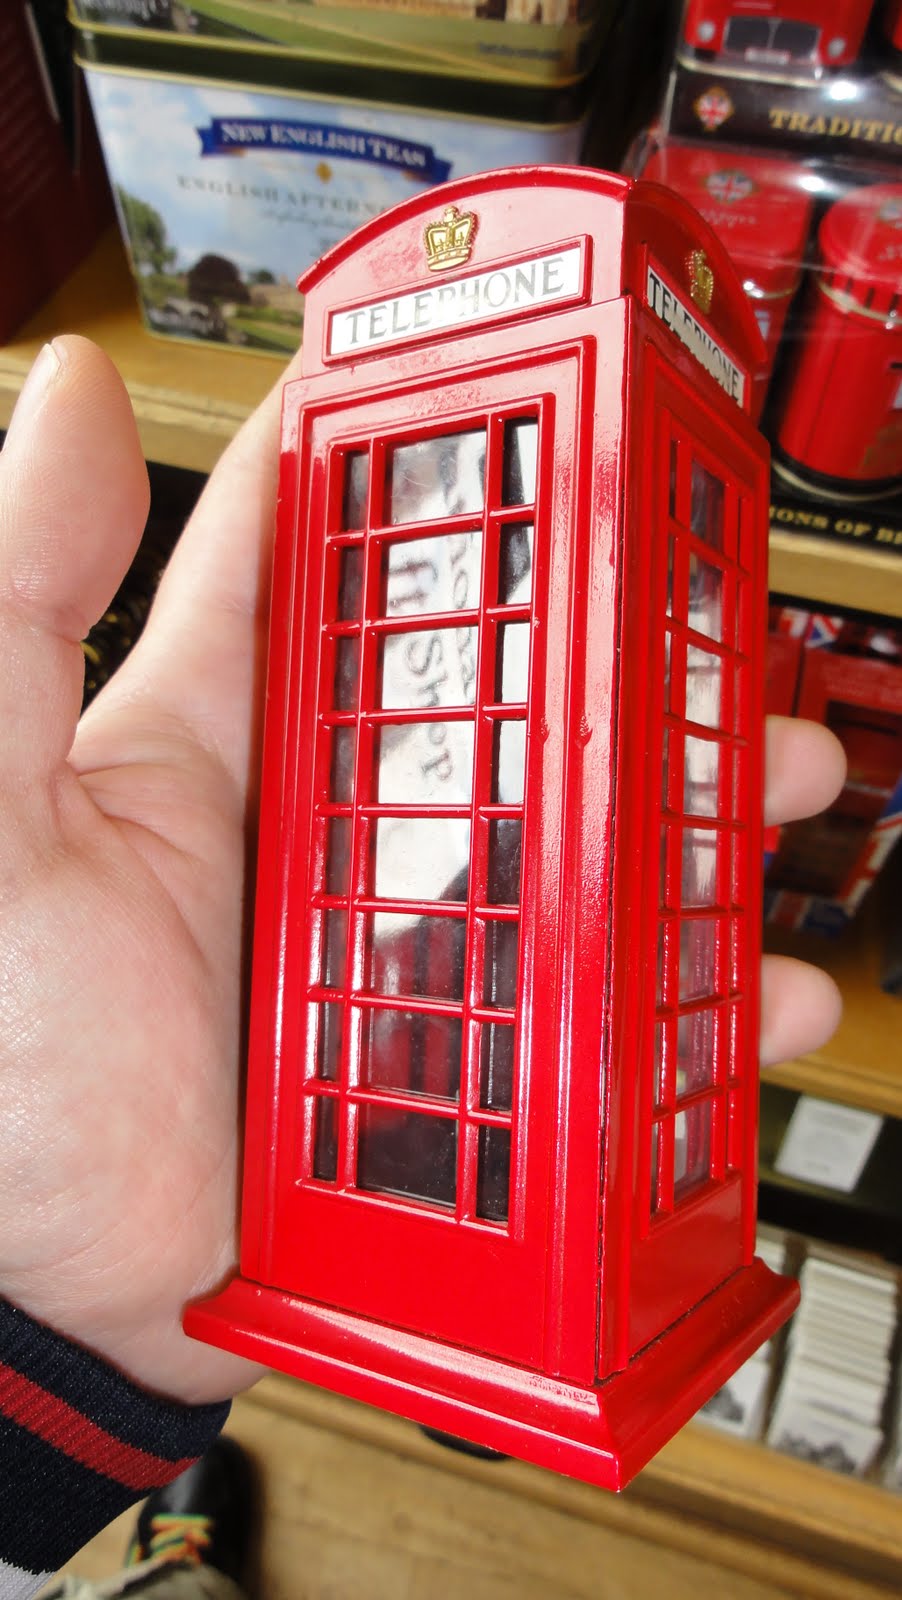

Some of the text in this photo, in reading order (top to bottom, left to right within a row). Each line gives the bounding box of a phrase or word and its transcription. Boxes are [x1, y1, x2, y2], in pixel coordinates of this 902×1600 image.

[221, 123, 426, 167] NEW ENGLISH TEAS
[177, 176, 279, 199] ENGLISH
[346, 257, 564, 344] TELEPHONE
[650, 272, 738, 401] TEONE
[834, 520, 871, 537] OF
